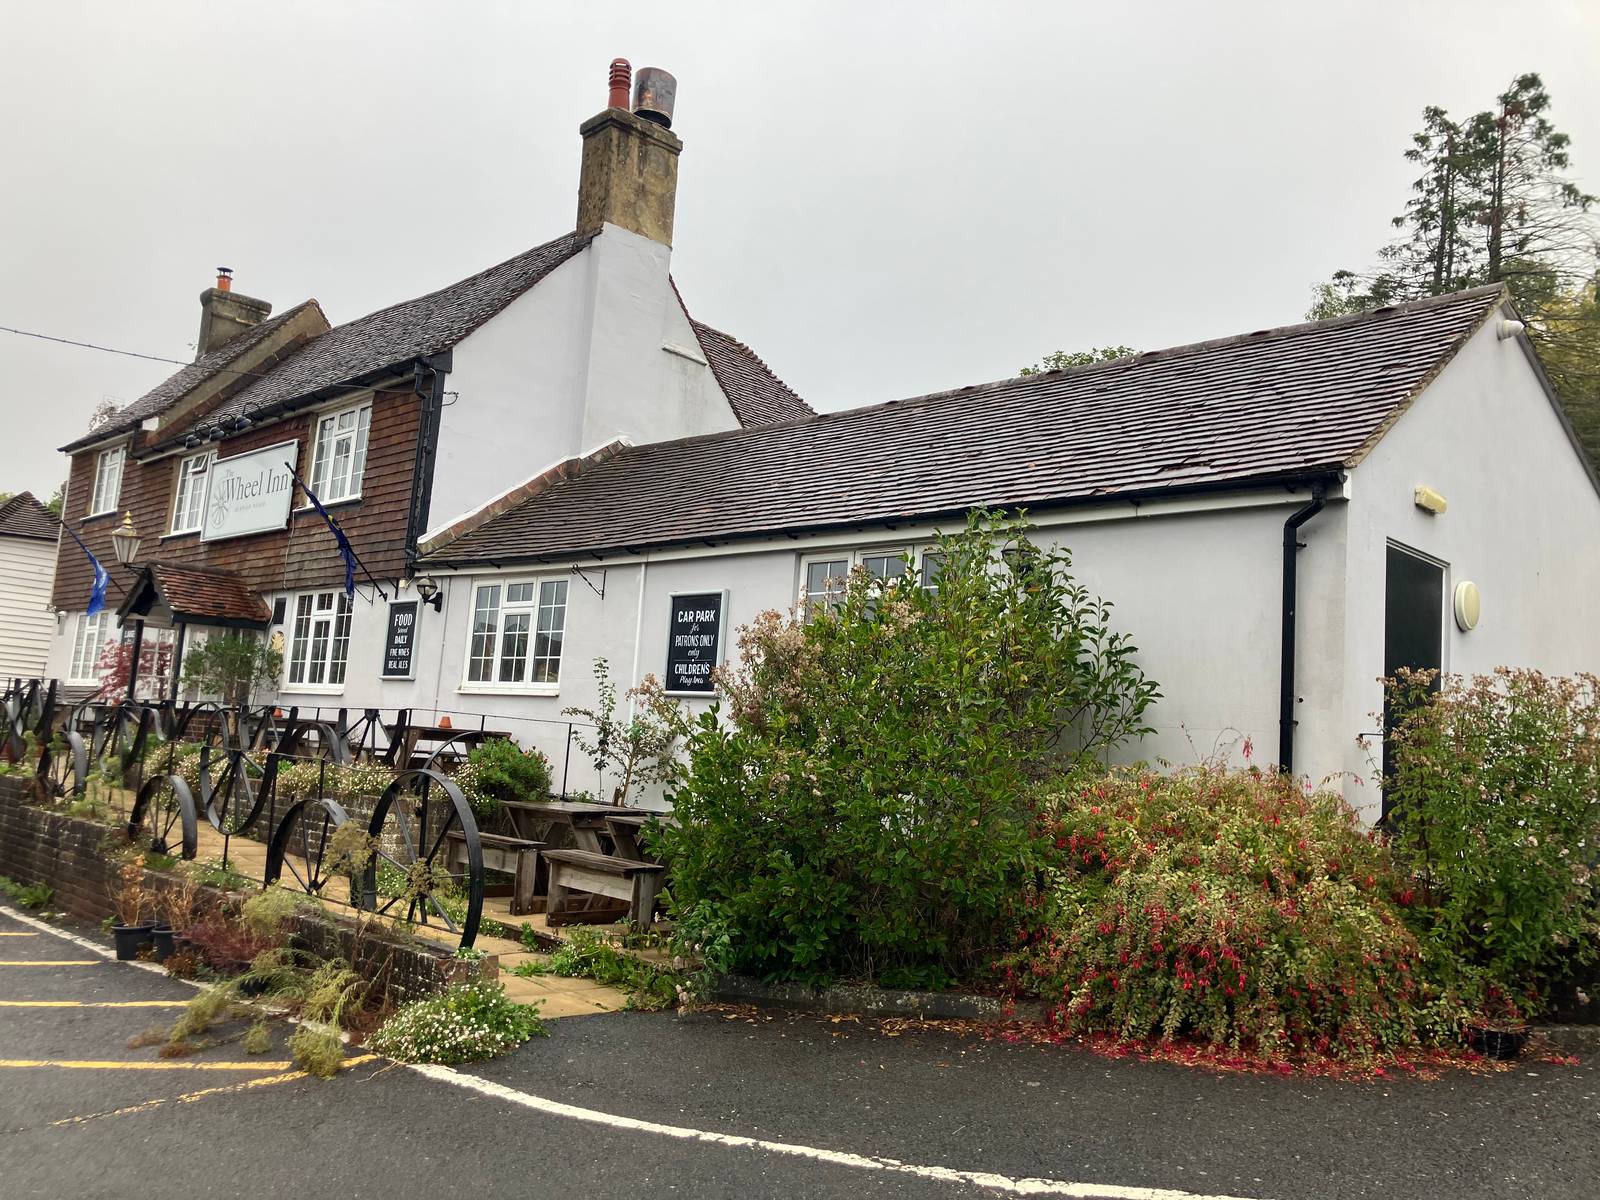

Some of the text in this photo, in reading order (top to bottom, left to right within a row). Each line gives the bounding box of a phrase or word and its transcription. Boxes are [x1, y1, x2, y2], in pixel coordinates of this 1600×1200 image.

[226, 469, 290, 501] Wheel Inn
[394, 613, 413, 627] FOOD
[678, 609, 716, 623] CAR PARK
[675, 634, 715, 647] PATRONS ONLY
[687, 648, 700, 659] only
[674, 662, 710, 675] CHILDREN'S
[679, 676, 691, 686] Play
